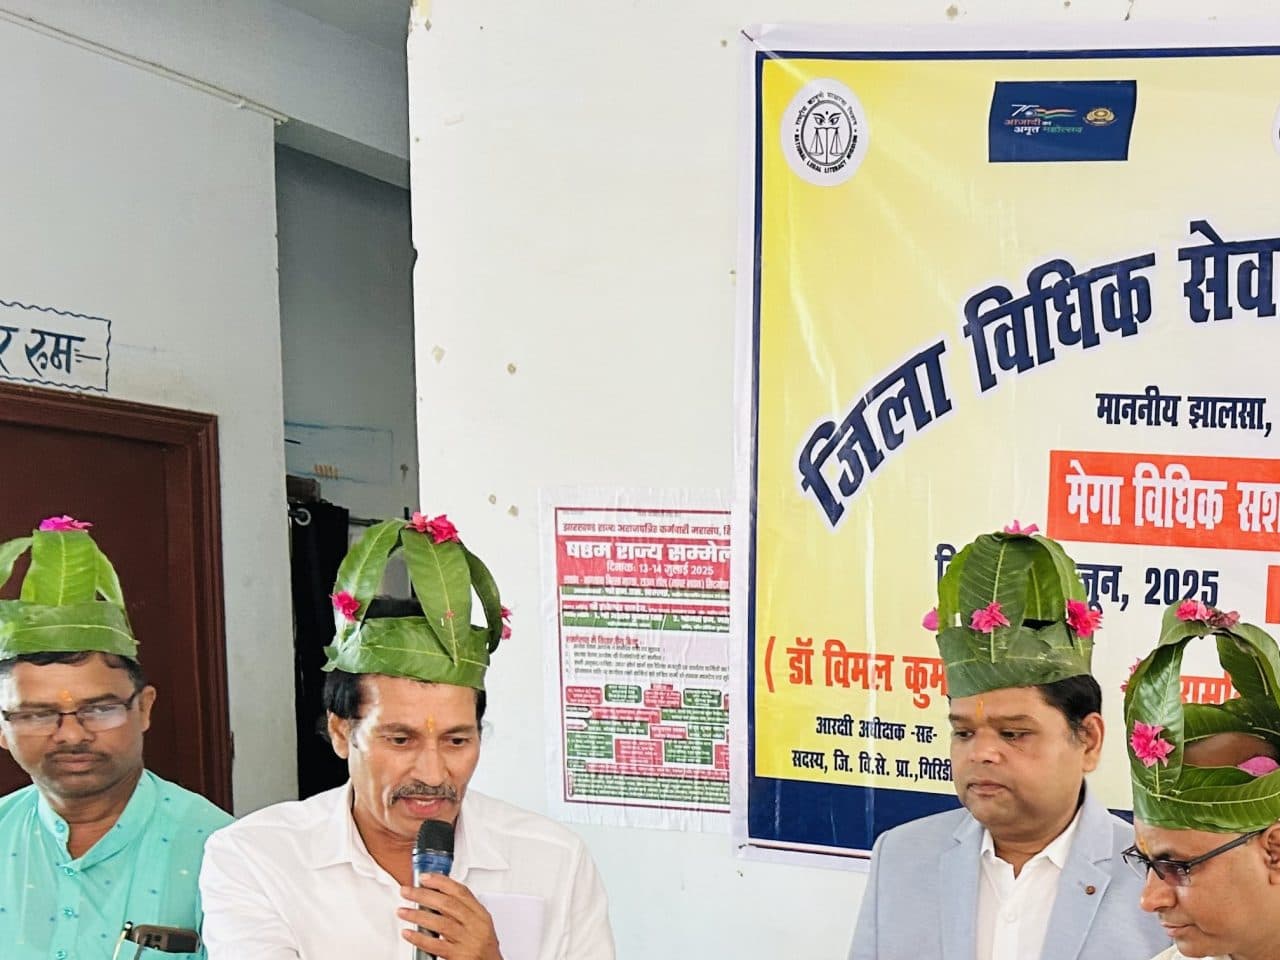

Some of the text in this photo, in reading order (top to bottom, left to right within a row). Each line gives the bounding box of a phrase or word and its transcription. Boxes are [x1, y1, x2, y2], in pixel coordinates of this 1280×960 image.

[800, 340, 952, 526] जिला
[964, 253, 1156, 392] विधिक
[1096, 386, 1181, 427] माननीय
[1188, 395, 1273, 437] झालसा,
[1066, 459, 1124, 526] मेगा
[1133, 462, 1228, 530] विधिक
[667, 540, 730, 562] सम्मेल
[1145, 567, 1219, 607] 2025
[787, 637, 814, 685] डॉ
[823, 639, 894, 691] विमल
[902, 656, 948, 709] कुम
[816, 714, 853, 737] आरक्षी
[859, 717, 906, 741] अधीक्षक
[792, 750, 828, 773] सदस्य,
